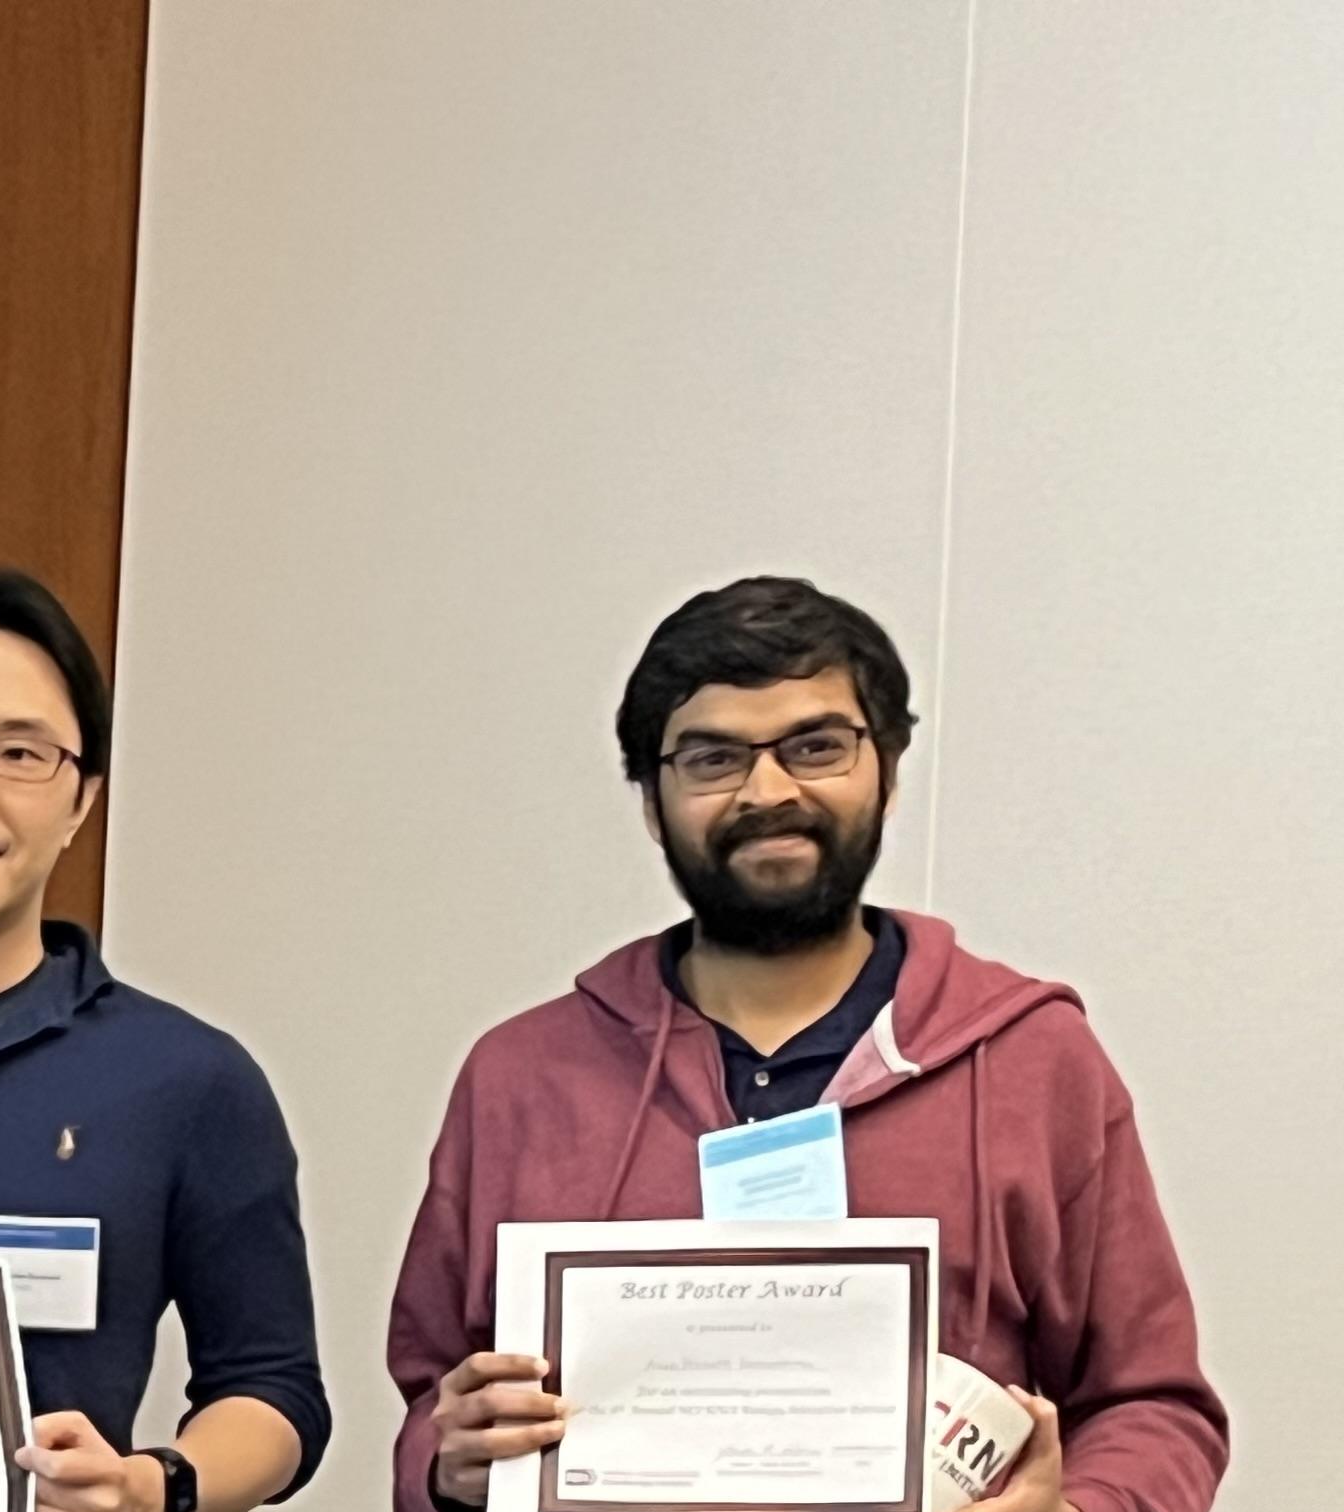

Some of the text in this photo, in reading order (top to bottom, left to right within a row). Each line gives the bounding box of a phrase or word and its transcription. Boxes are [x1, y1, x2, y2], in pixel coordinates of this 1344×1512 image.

[620, 1275, 853, 1300] Best Poster Award
